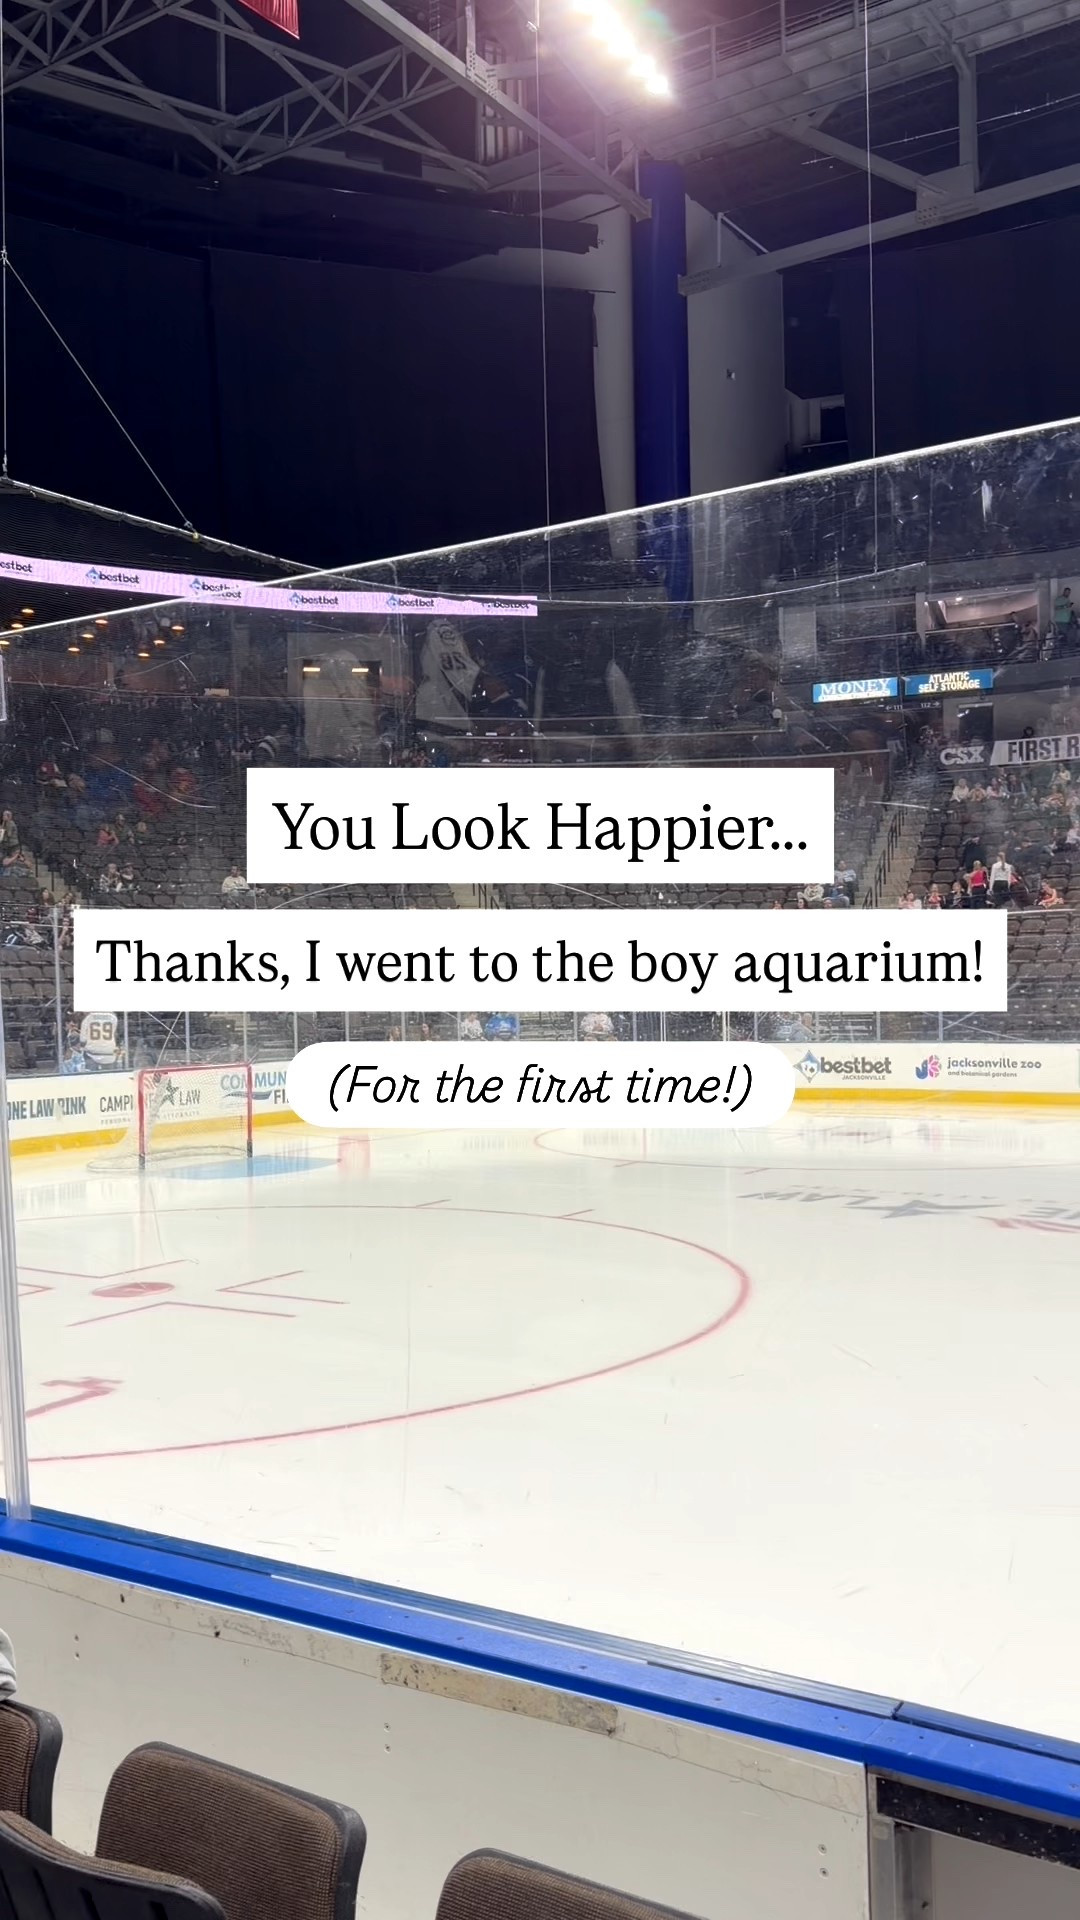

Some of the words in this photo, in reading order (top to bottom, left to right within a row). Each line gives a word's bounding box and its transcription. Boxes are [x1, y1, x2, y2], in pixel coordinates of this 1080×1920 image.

[99, 570, 140, 584] bestbet
[301, 595, 339, 605] bestbet
[398, 599, 435, 608] bestbet
[918, 682, 939, 693] SELF
[940, 678, 981, 691] STORAGE
[928, 671, 970, 684] ATLANTIC
[820, 679, 890, 696] MONEY
[940, 745, 985, 765] CSX
[1008, 737, 1062, 763] FIRST
[90, 1021, 113, 1041] 69
[821, 1056, 892, 1074] bestbet
[947, 1057, 1018, 1069] jacksonville
[1021, 1060, 1042, 1069] zoo
[179, 1090, 201, 1106] LAW
[274, 1089, 289, 1105] FI
[30, 1099, 55, 1118] LAW
